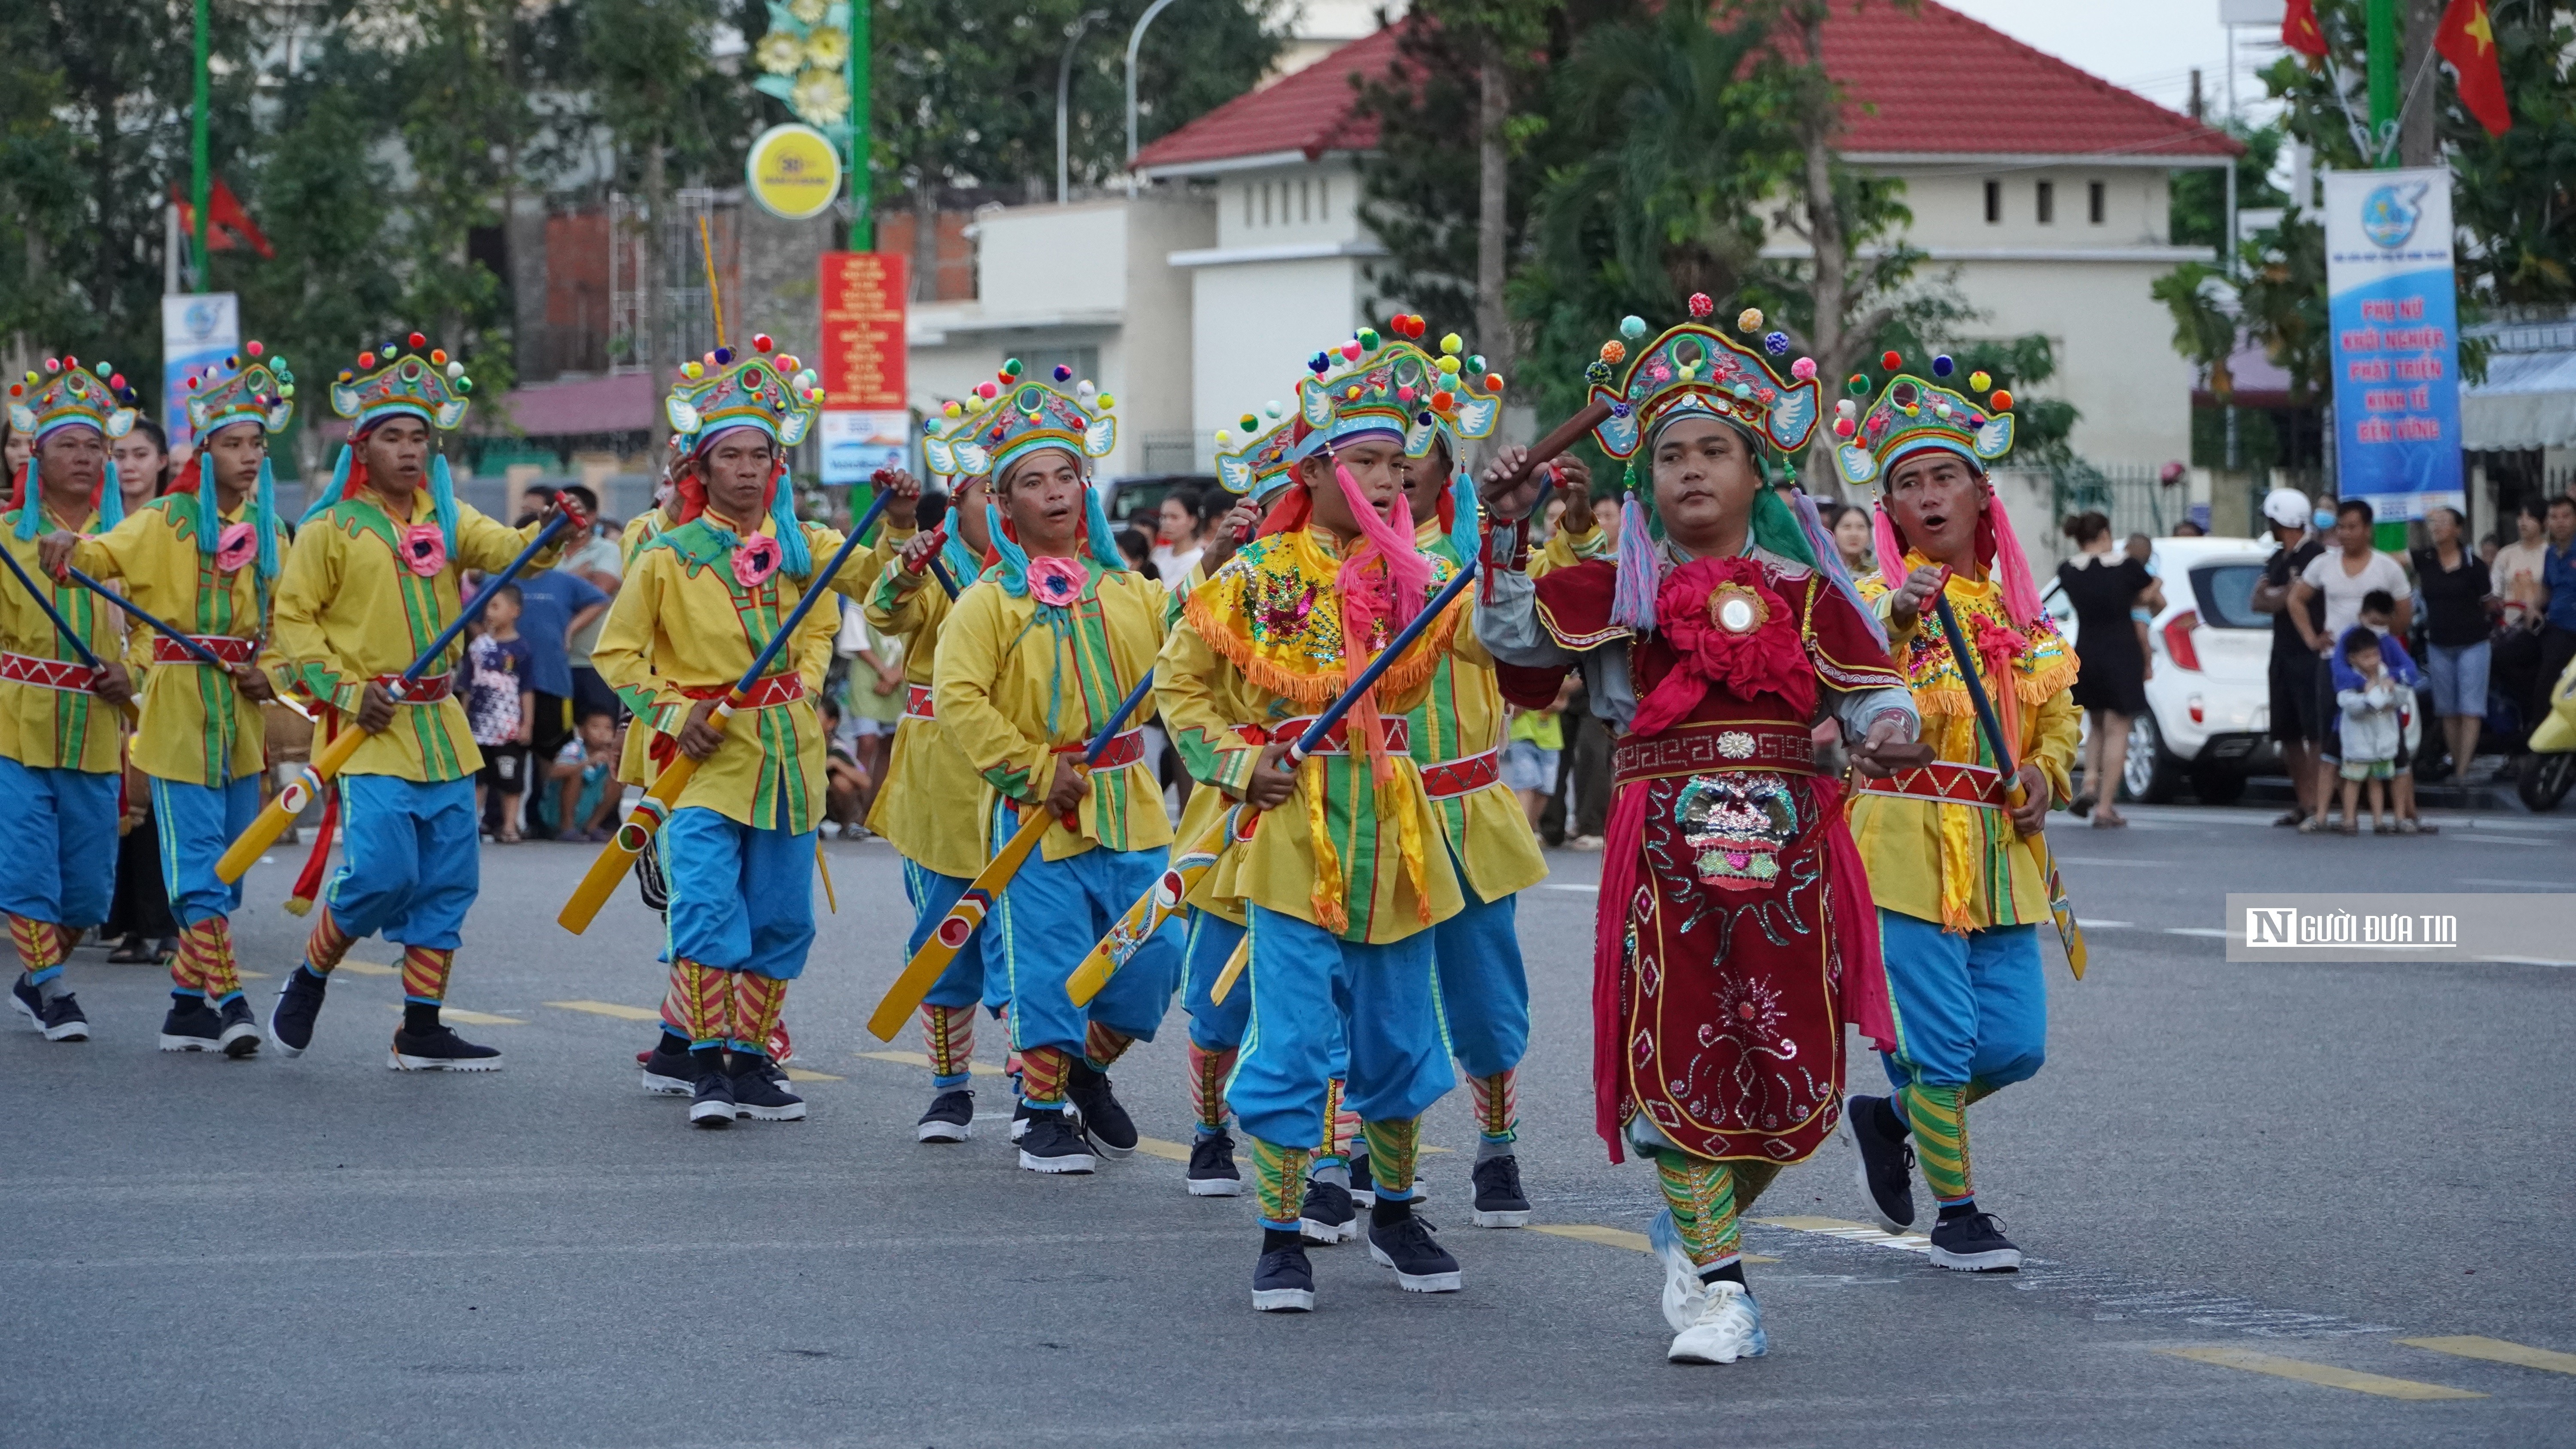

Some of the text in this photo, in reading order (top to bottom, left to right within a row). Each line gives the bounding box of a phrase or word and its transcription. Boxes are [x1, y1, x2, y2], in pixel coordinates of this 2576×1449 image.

[2362, 294, 2424, 323] PHỤ NỮ
[2350, 349, 2442, 382] PHÁT TRIỂN
[2366, 383, 2429, 410] KINH TẾ
[2357, 416, 2439, 443] BỀN VỮNG
